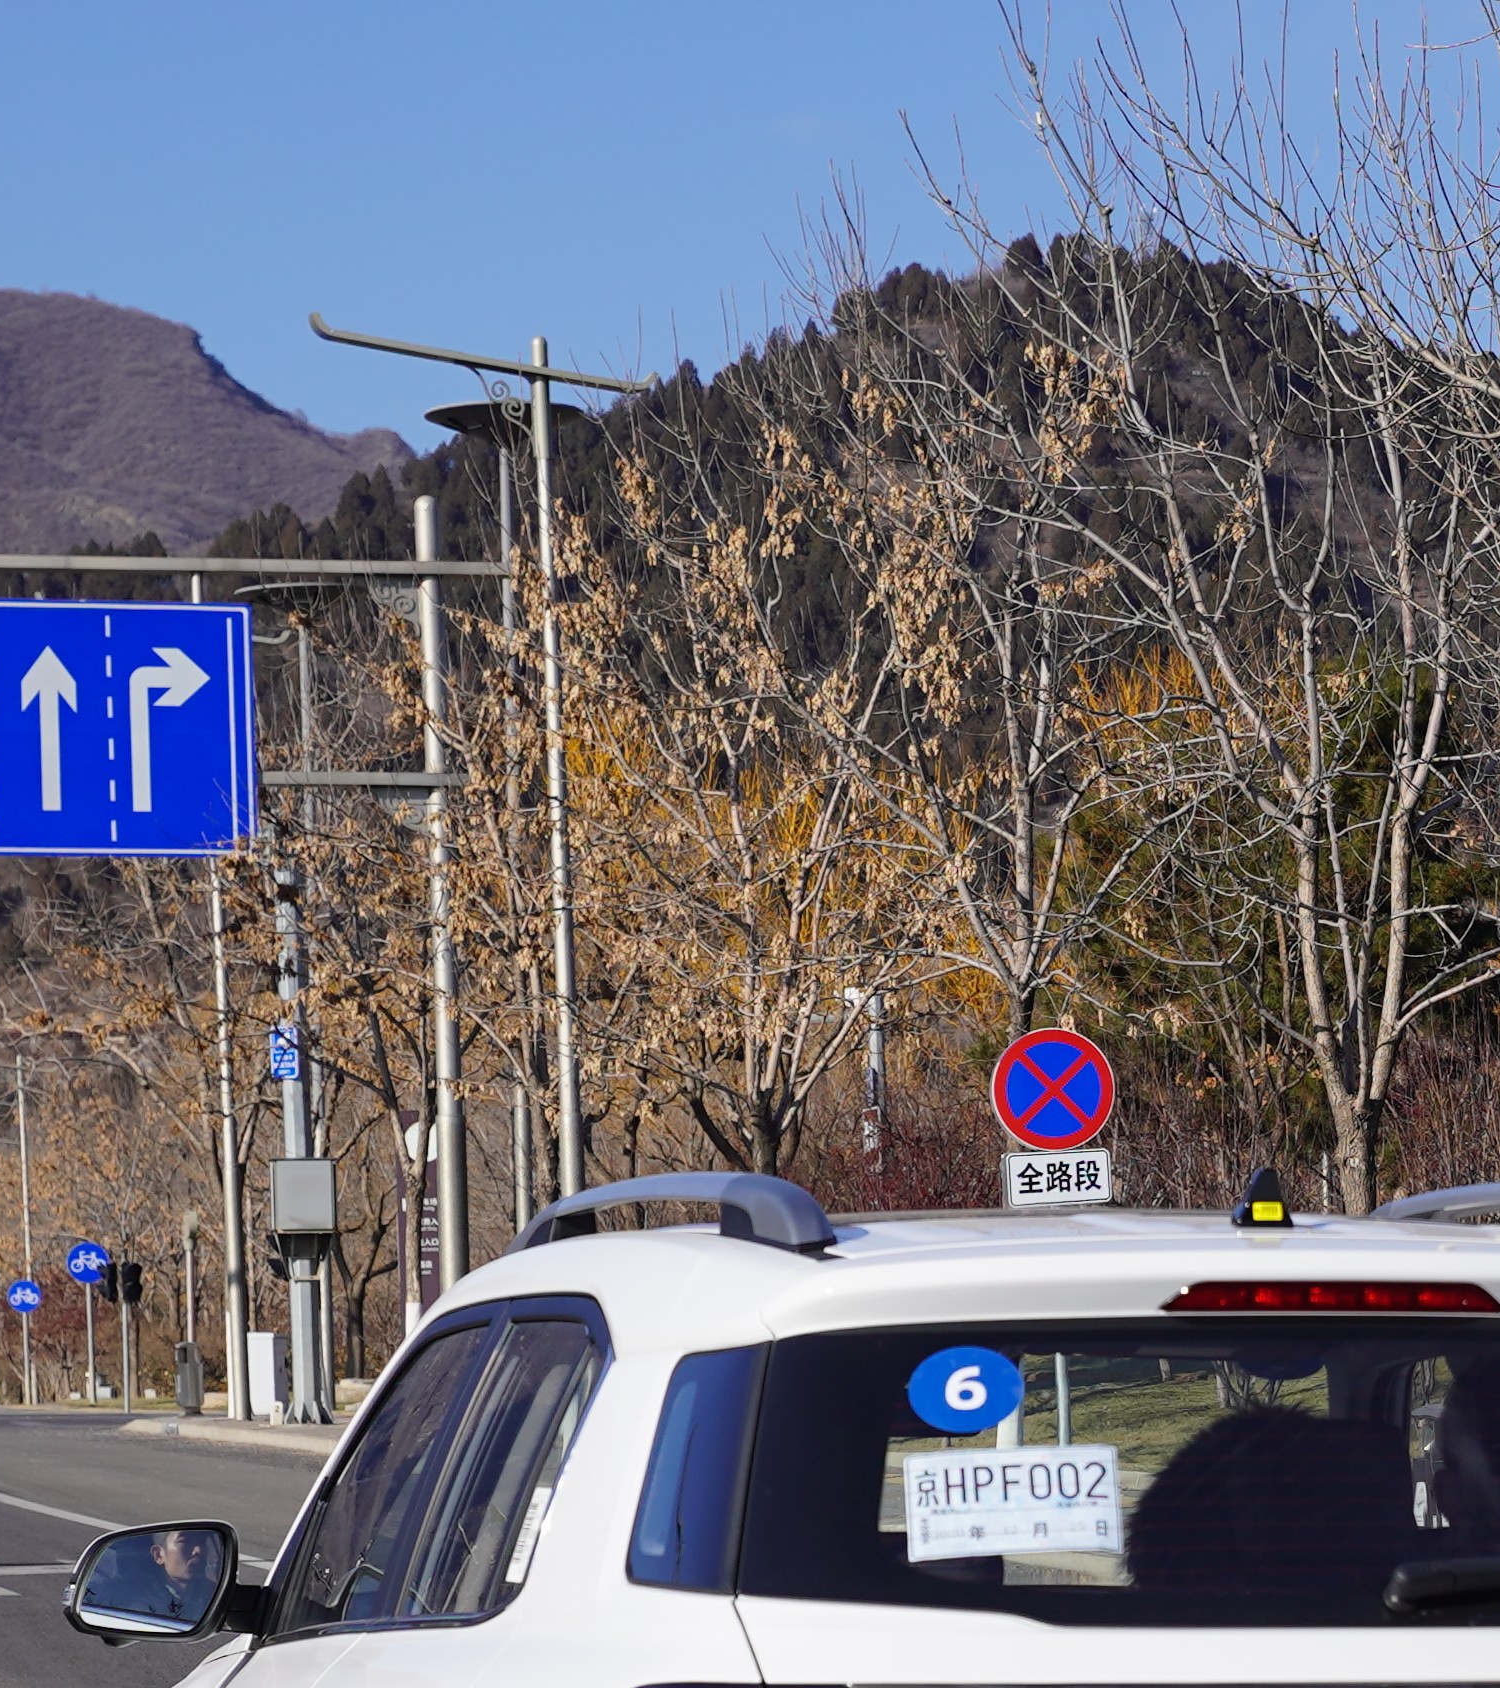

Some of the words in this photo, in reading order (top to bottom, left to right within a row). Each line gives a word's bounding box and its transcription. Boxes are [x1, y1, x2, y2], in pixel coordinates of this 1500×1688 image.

[1017, 1159, 1102, 1195] 全路段
[943, 1364, 988, 1412] 6
[914, 1461, 1110, 1508] 京HPF002
